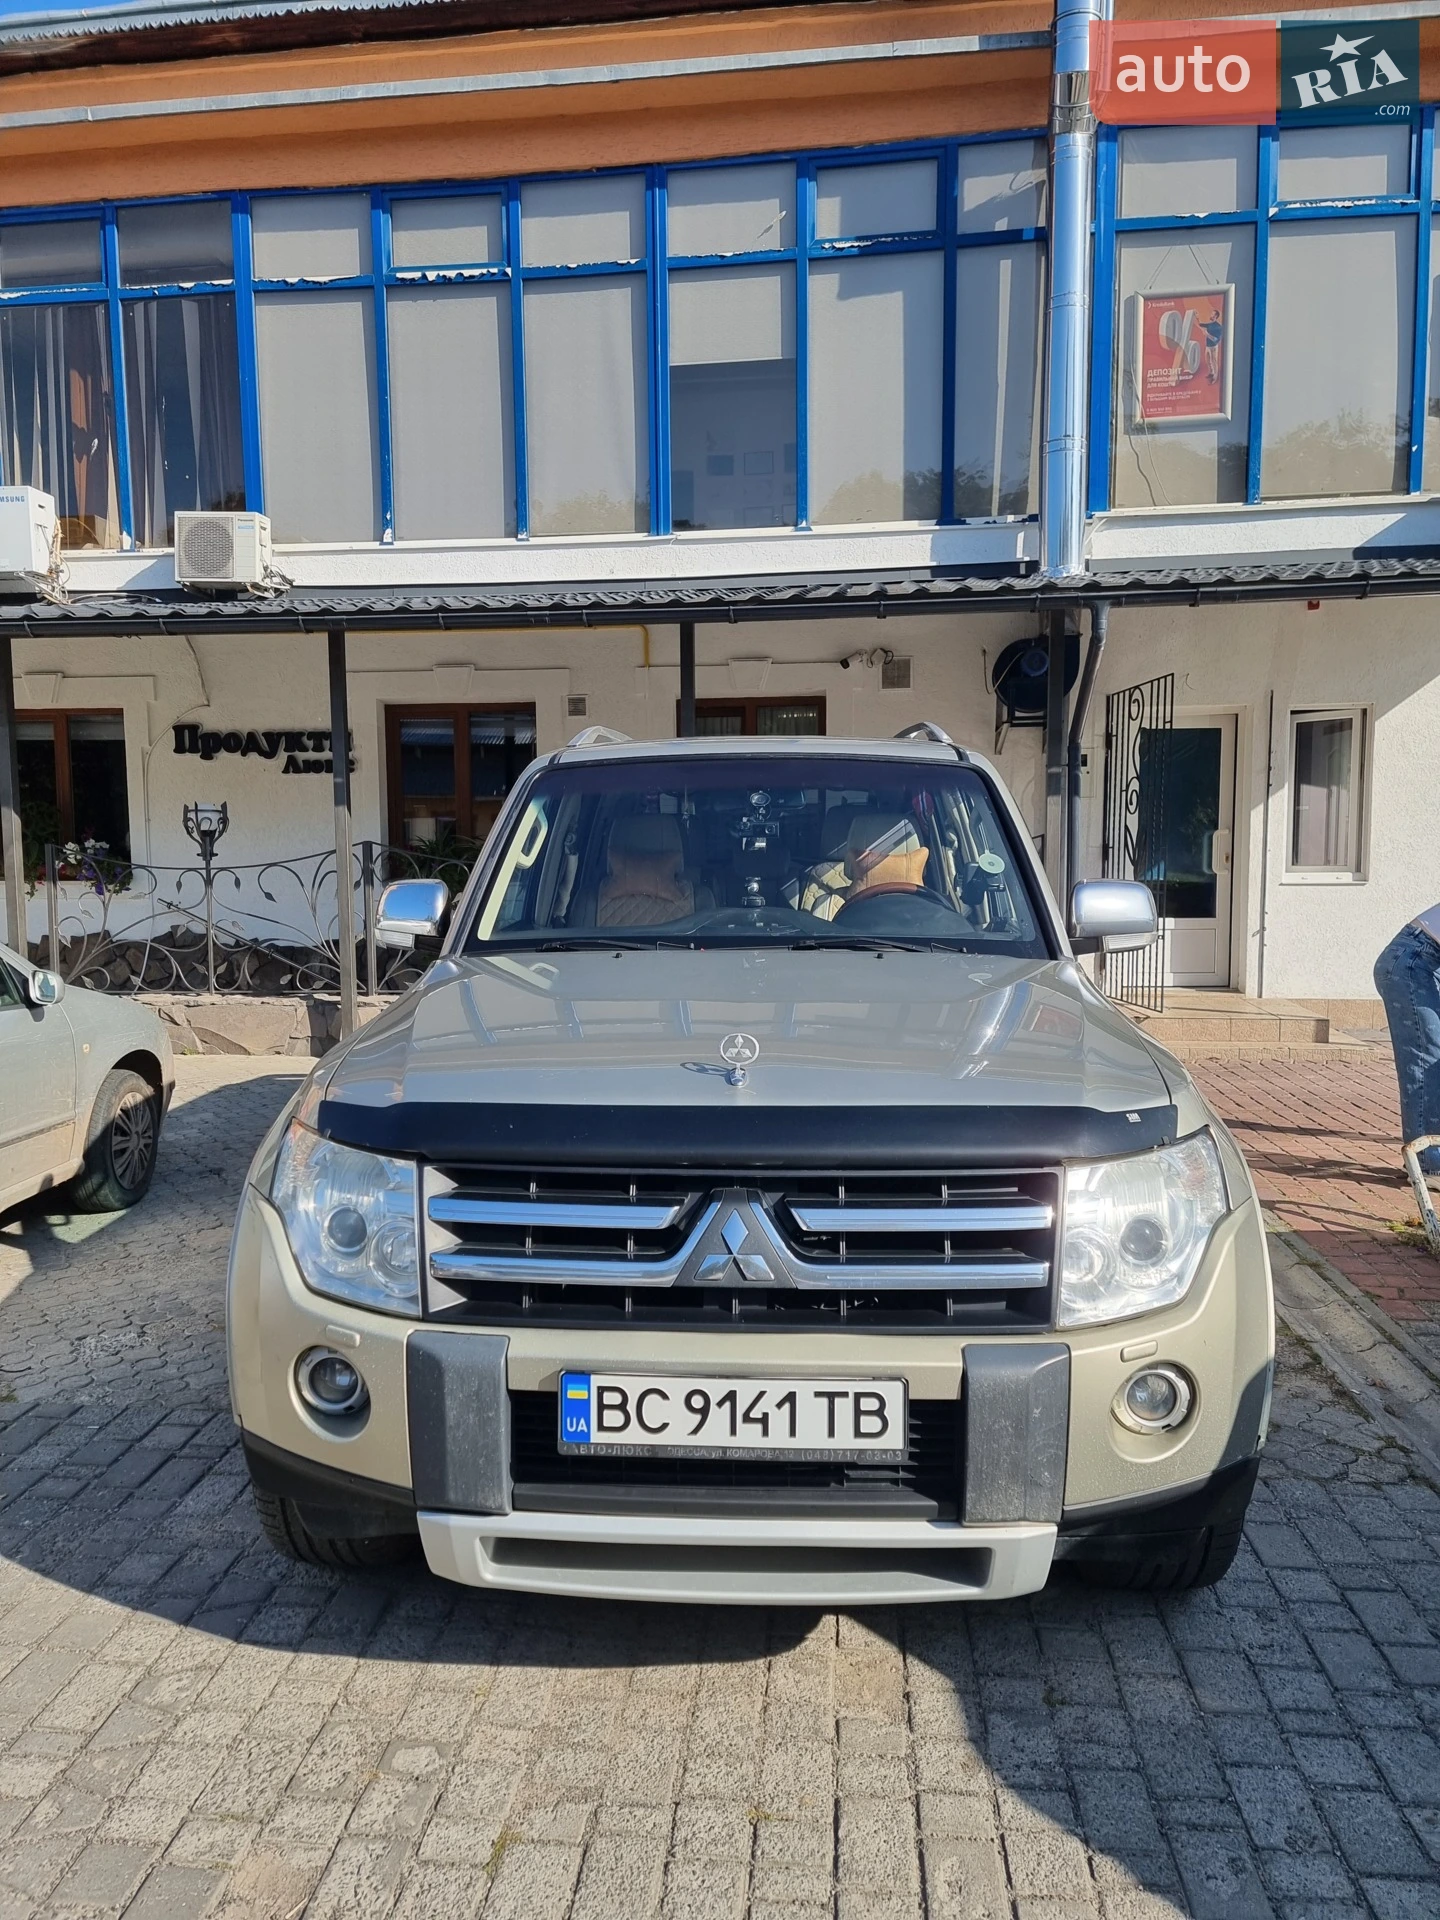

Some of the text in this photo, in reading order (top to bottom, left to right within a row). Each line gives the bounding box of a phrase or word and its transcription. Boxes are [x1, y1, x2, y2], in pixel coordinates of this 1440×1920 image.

[566, 1416, 588, 1433] UA
[597, 1386, 889, 1439] BC 9141 TB
